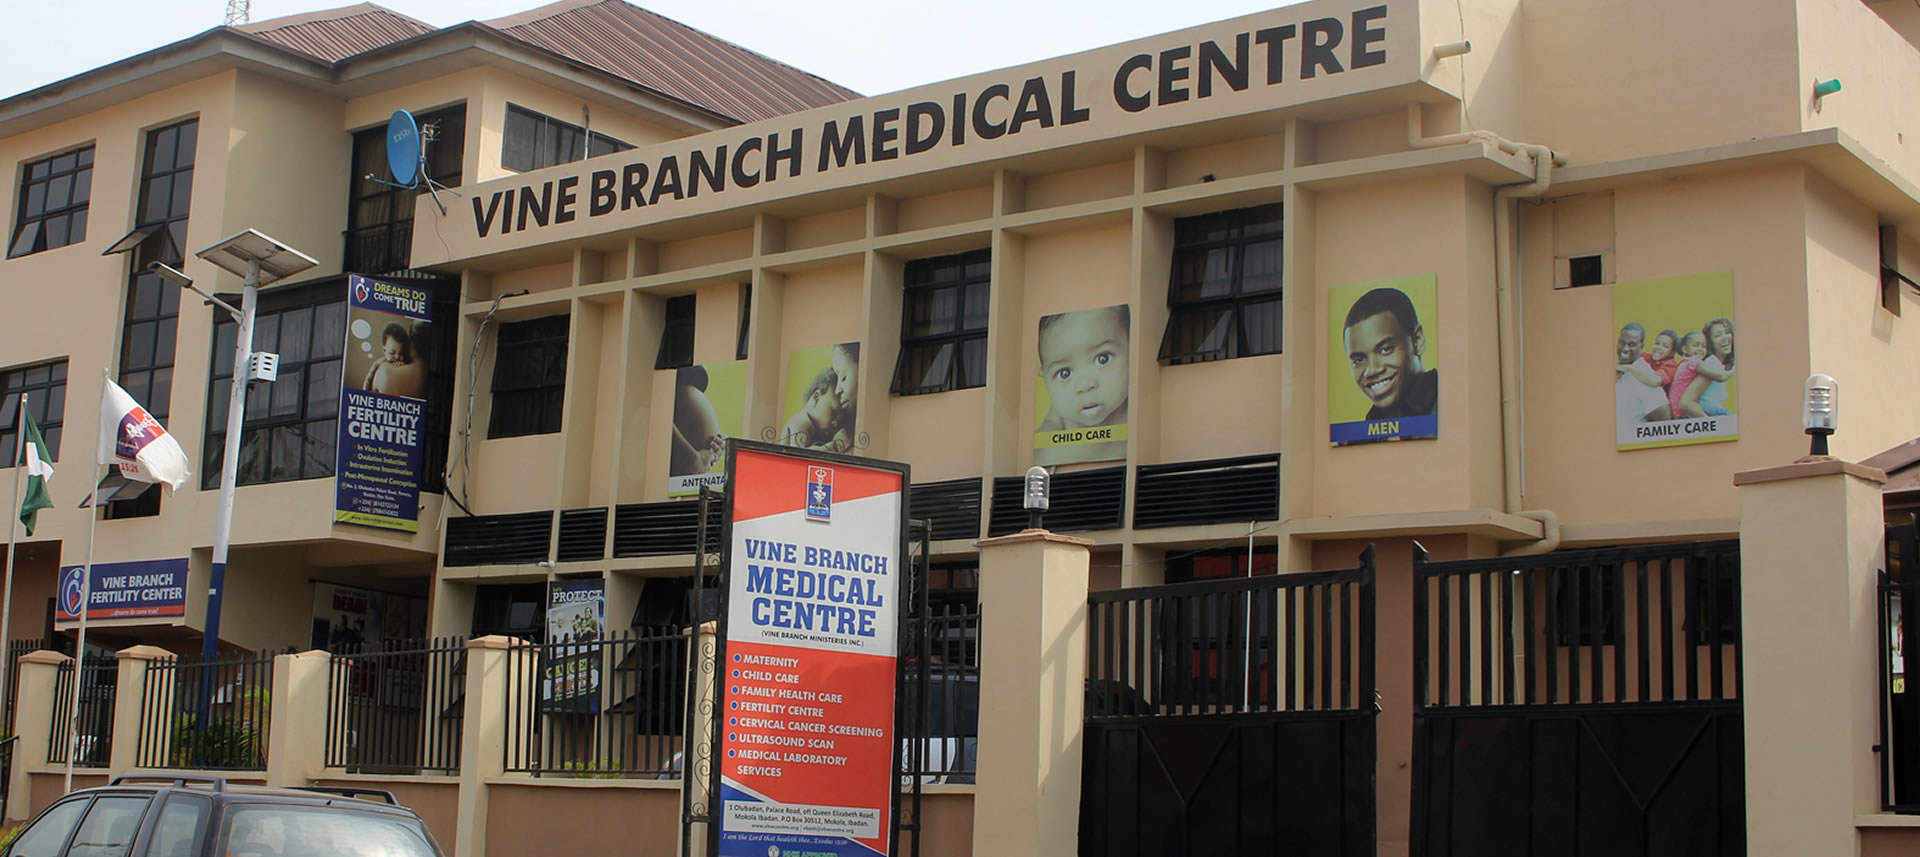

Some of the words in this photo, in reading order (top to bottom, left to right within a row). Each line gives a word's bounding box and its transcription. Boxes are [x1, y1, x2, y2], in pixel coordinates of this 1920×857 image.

[471, 176, 579, 238] VINE
[589, 128, 803, 218] BRANCH
[818, 70, 1090, 172] MEDICAL
[1113, 4, 1387, 113] CENTRE
[374, 282, 410, 298] DREAMS
[412, 291, 426, 301] DO
[374, 292, 394, 303] COME
[395, 297, 425, 314] TRUE
[349, 393, 374, 408] VINE
[376, 398, 421, 415] BRANCH
[348, 406, 419, 430] FERTILITY
[348, 421, 417, 446] CENTRE
[1052, 432, 1082, 443] CHILD
[1086, 429, 1111, 440] CARE
[1368, 421, 1399, 436] MEN
[1636, 424, 1681, 438] FAMILY
[1685, 421, 1716, 434] CARE
[745, 538, 797, 564] VINE
[804, 546, 888, 575] BRANCH
[102, 576, 127, 589] VINE
[128, 573, 174, 588] BRANCH
[746, 565, 883, 607] MEDICAL
[90, 589, 140, 604] FERTILITY
[142, 587, 182, 601] CENTER
[552, 589, 602, 603] PROTECT
[752, 597, 876, 638] CENTRE
[761, 630, 779, 638] (VINE
[781, 632, 808, 641] BRANCH
[809, 635, 847, 645] MINISTERIES
[849, 640, 864, 648] INC.)
[743, 654, 799, 668] MATERNITY
[742, 670, 772, 681] CHILD
[775, 673, 799, 684] CARE
[741, 685, 777, 698] FAMILY
[778, 689, 816, 701] HEALTH
[818, 693, 843, 703] CARE
[740, 702, 786, 714] FERTILITY
[788, 705, 824, 717] CENTRE
[739, 718, 785, 730] CERVICAL
[787, 721, 826, 733] CANCER
[828, 725, 884, 738] SCREENING
[739, 733, 805, 747] ULTRASOUND
[807, 738, 834, 749] SCAN
[738, 749, 781, 761] MEDICAL
[783, 753, 847, 766] LABORATORY
[737, 765, 782, 777] SERVICES
[734, 813, 757, 821] Mokola
[803, 808, 811, 816] off
[812, 809, 832, 817] Queen
[832, 809, 858, 818] Elizabeth
[859, 811, 876, 819] Road,
